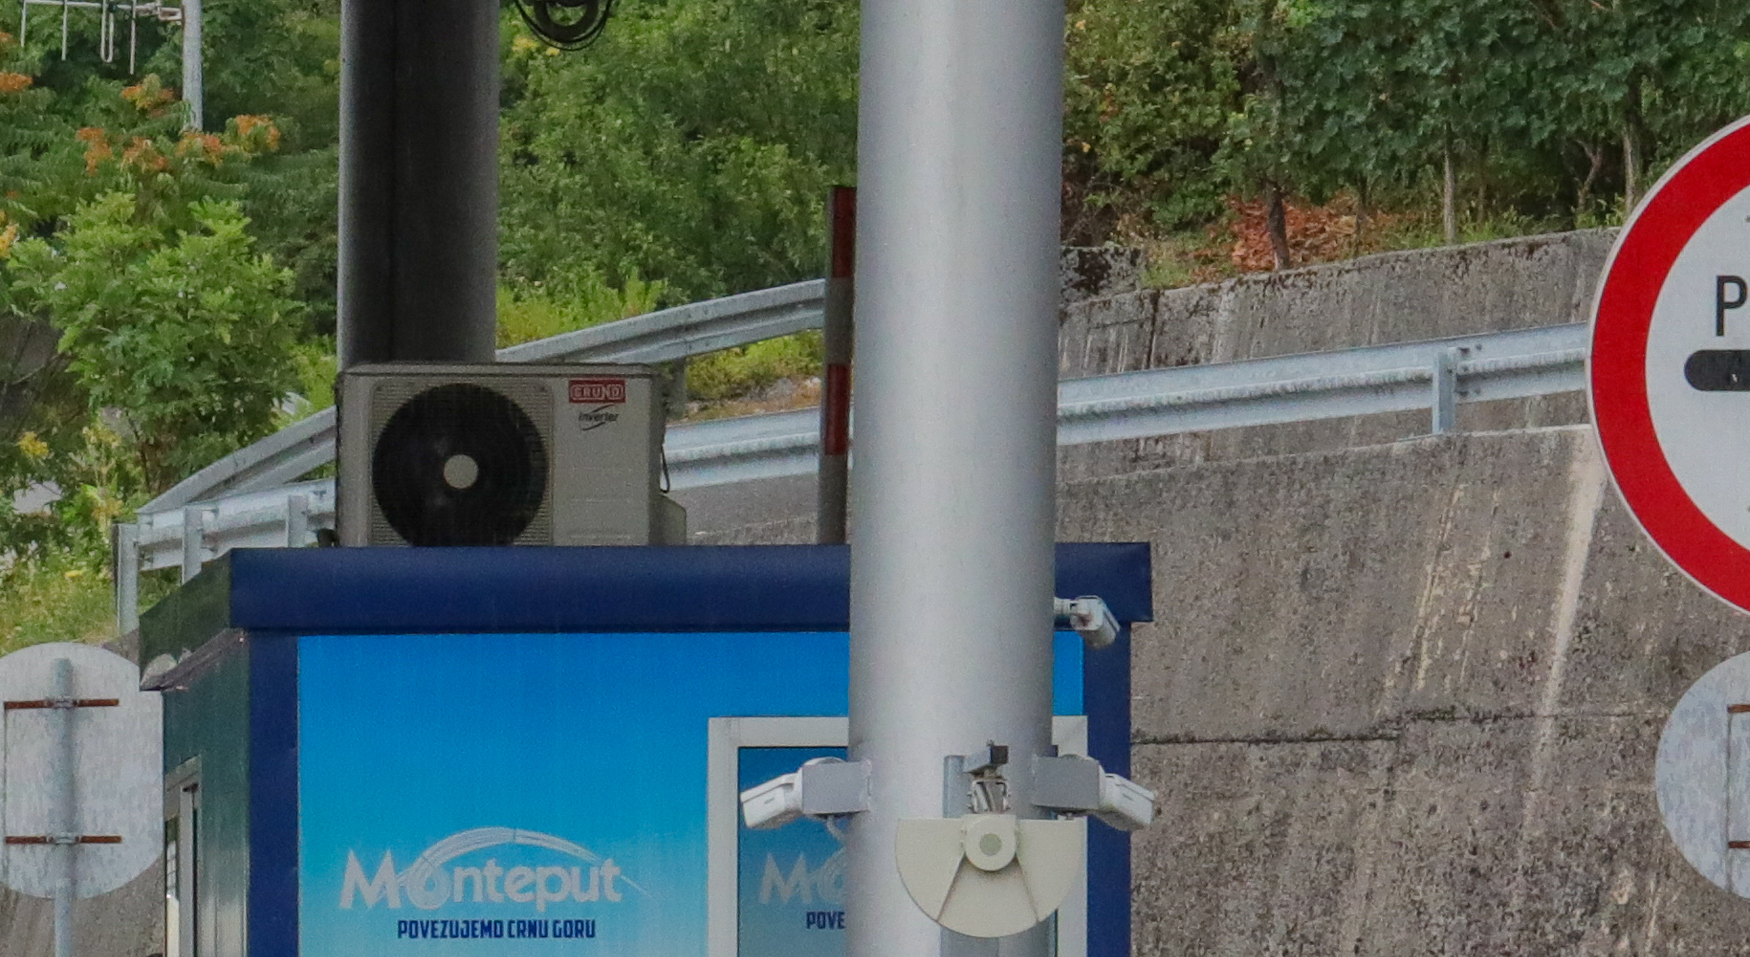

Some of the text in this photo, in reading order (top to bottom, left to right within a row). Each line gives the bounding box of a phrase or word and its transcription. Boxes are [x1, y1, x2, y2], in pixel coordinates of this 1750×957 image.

[339, 849, 624, 912] Monteput
[397, 919, 596, 939] POVEZUJEMO CRNU GORU
[805, 911, 846, 930] POVE
